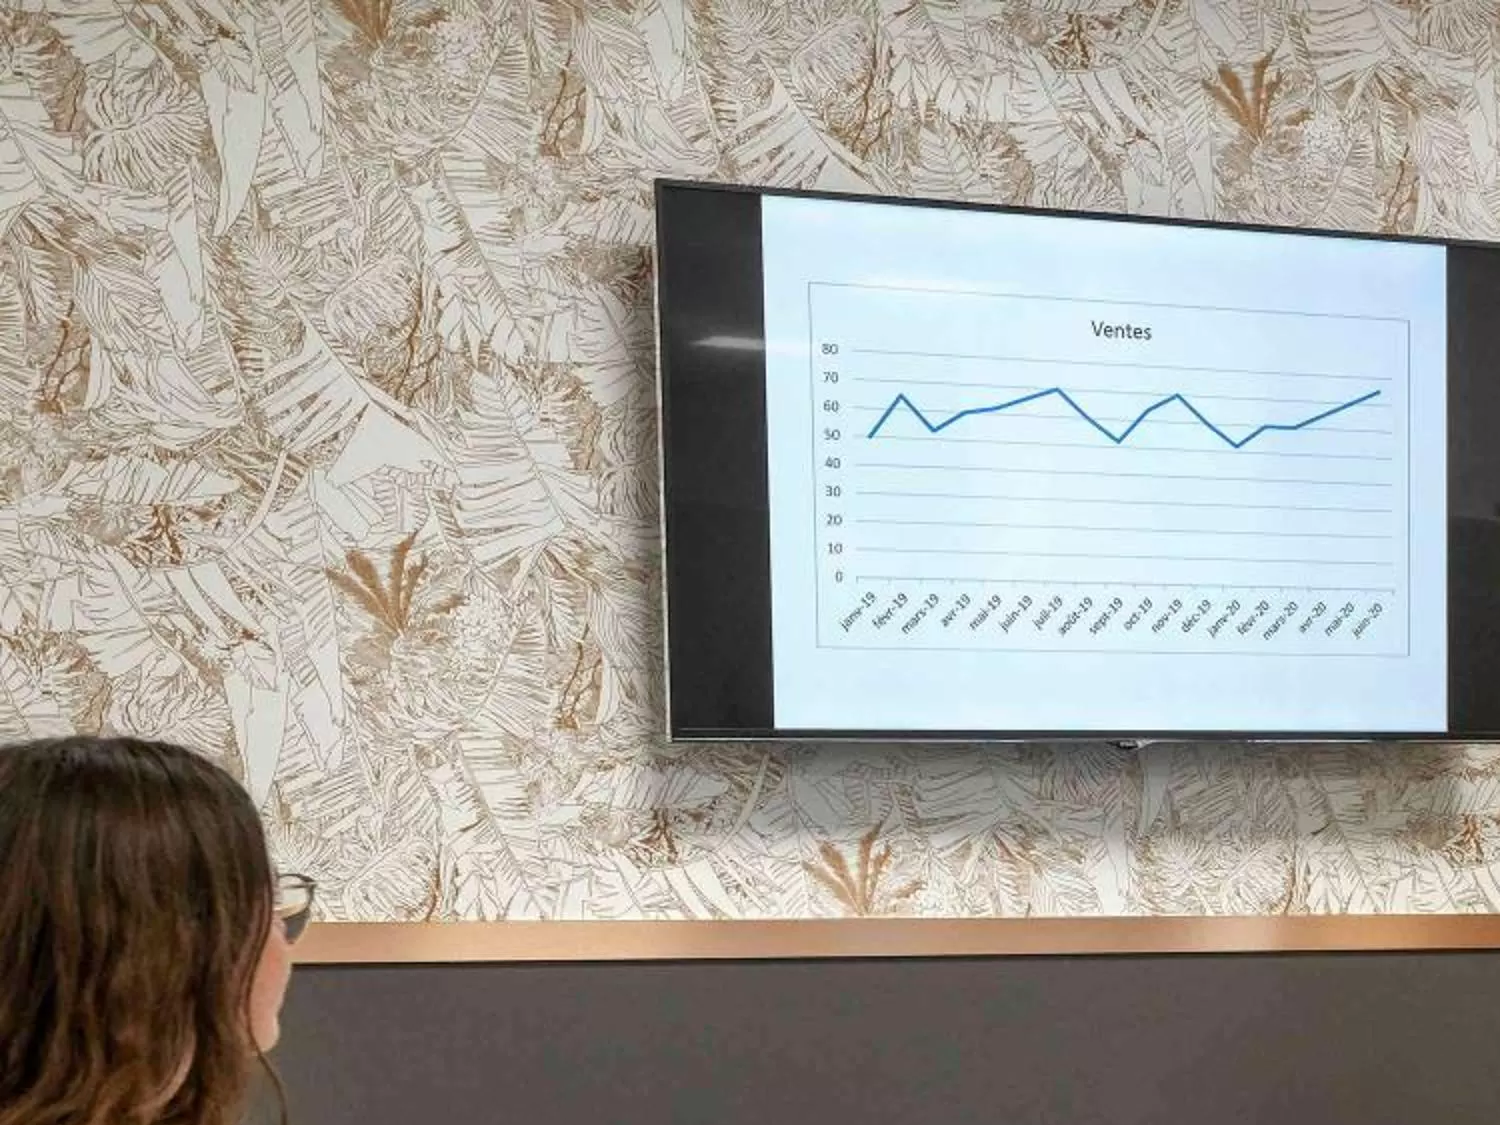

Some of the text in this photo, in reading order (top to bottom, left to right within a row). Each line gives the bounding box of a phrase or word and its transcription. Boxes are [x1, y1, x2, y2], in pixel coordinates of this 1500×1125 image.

[1091, 320, 1152, 340] Ventes
[821, 343, 839, 355] 80
[822, 372, 839, 384] 70
[823, 400, 840, 412] 60
[823, 428, 841, 441] 50
[824, 457, 841, 469] 40
[825, 485, 841, 497] 30
[826, 513, 843, 526] 20
[827, 542, 843, 555] 10
[835, 570, 844, 583] 0
[901, 593, 939, 634] mars-19
[941, 593, 971, 628] avr-19
[969, 594, 1001, 630] mai-19
[999, 595, 1033, 634] juin-19
[1089, 597, 1123, 635] sept-19
[1123, 597, 1153, 631] oct-19
[1151, 598, 1183, 633] nov-19
[1263, 601, 1299, 640] mars-20
